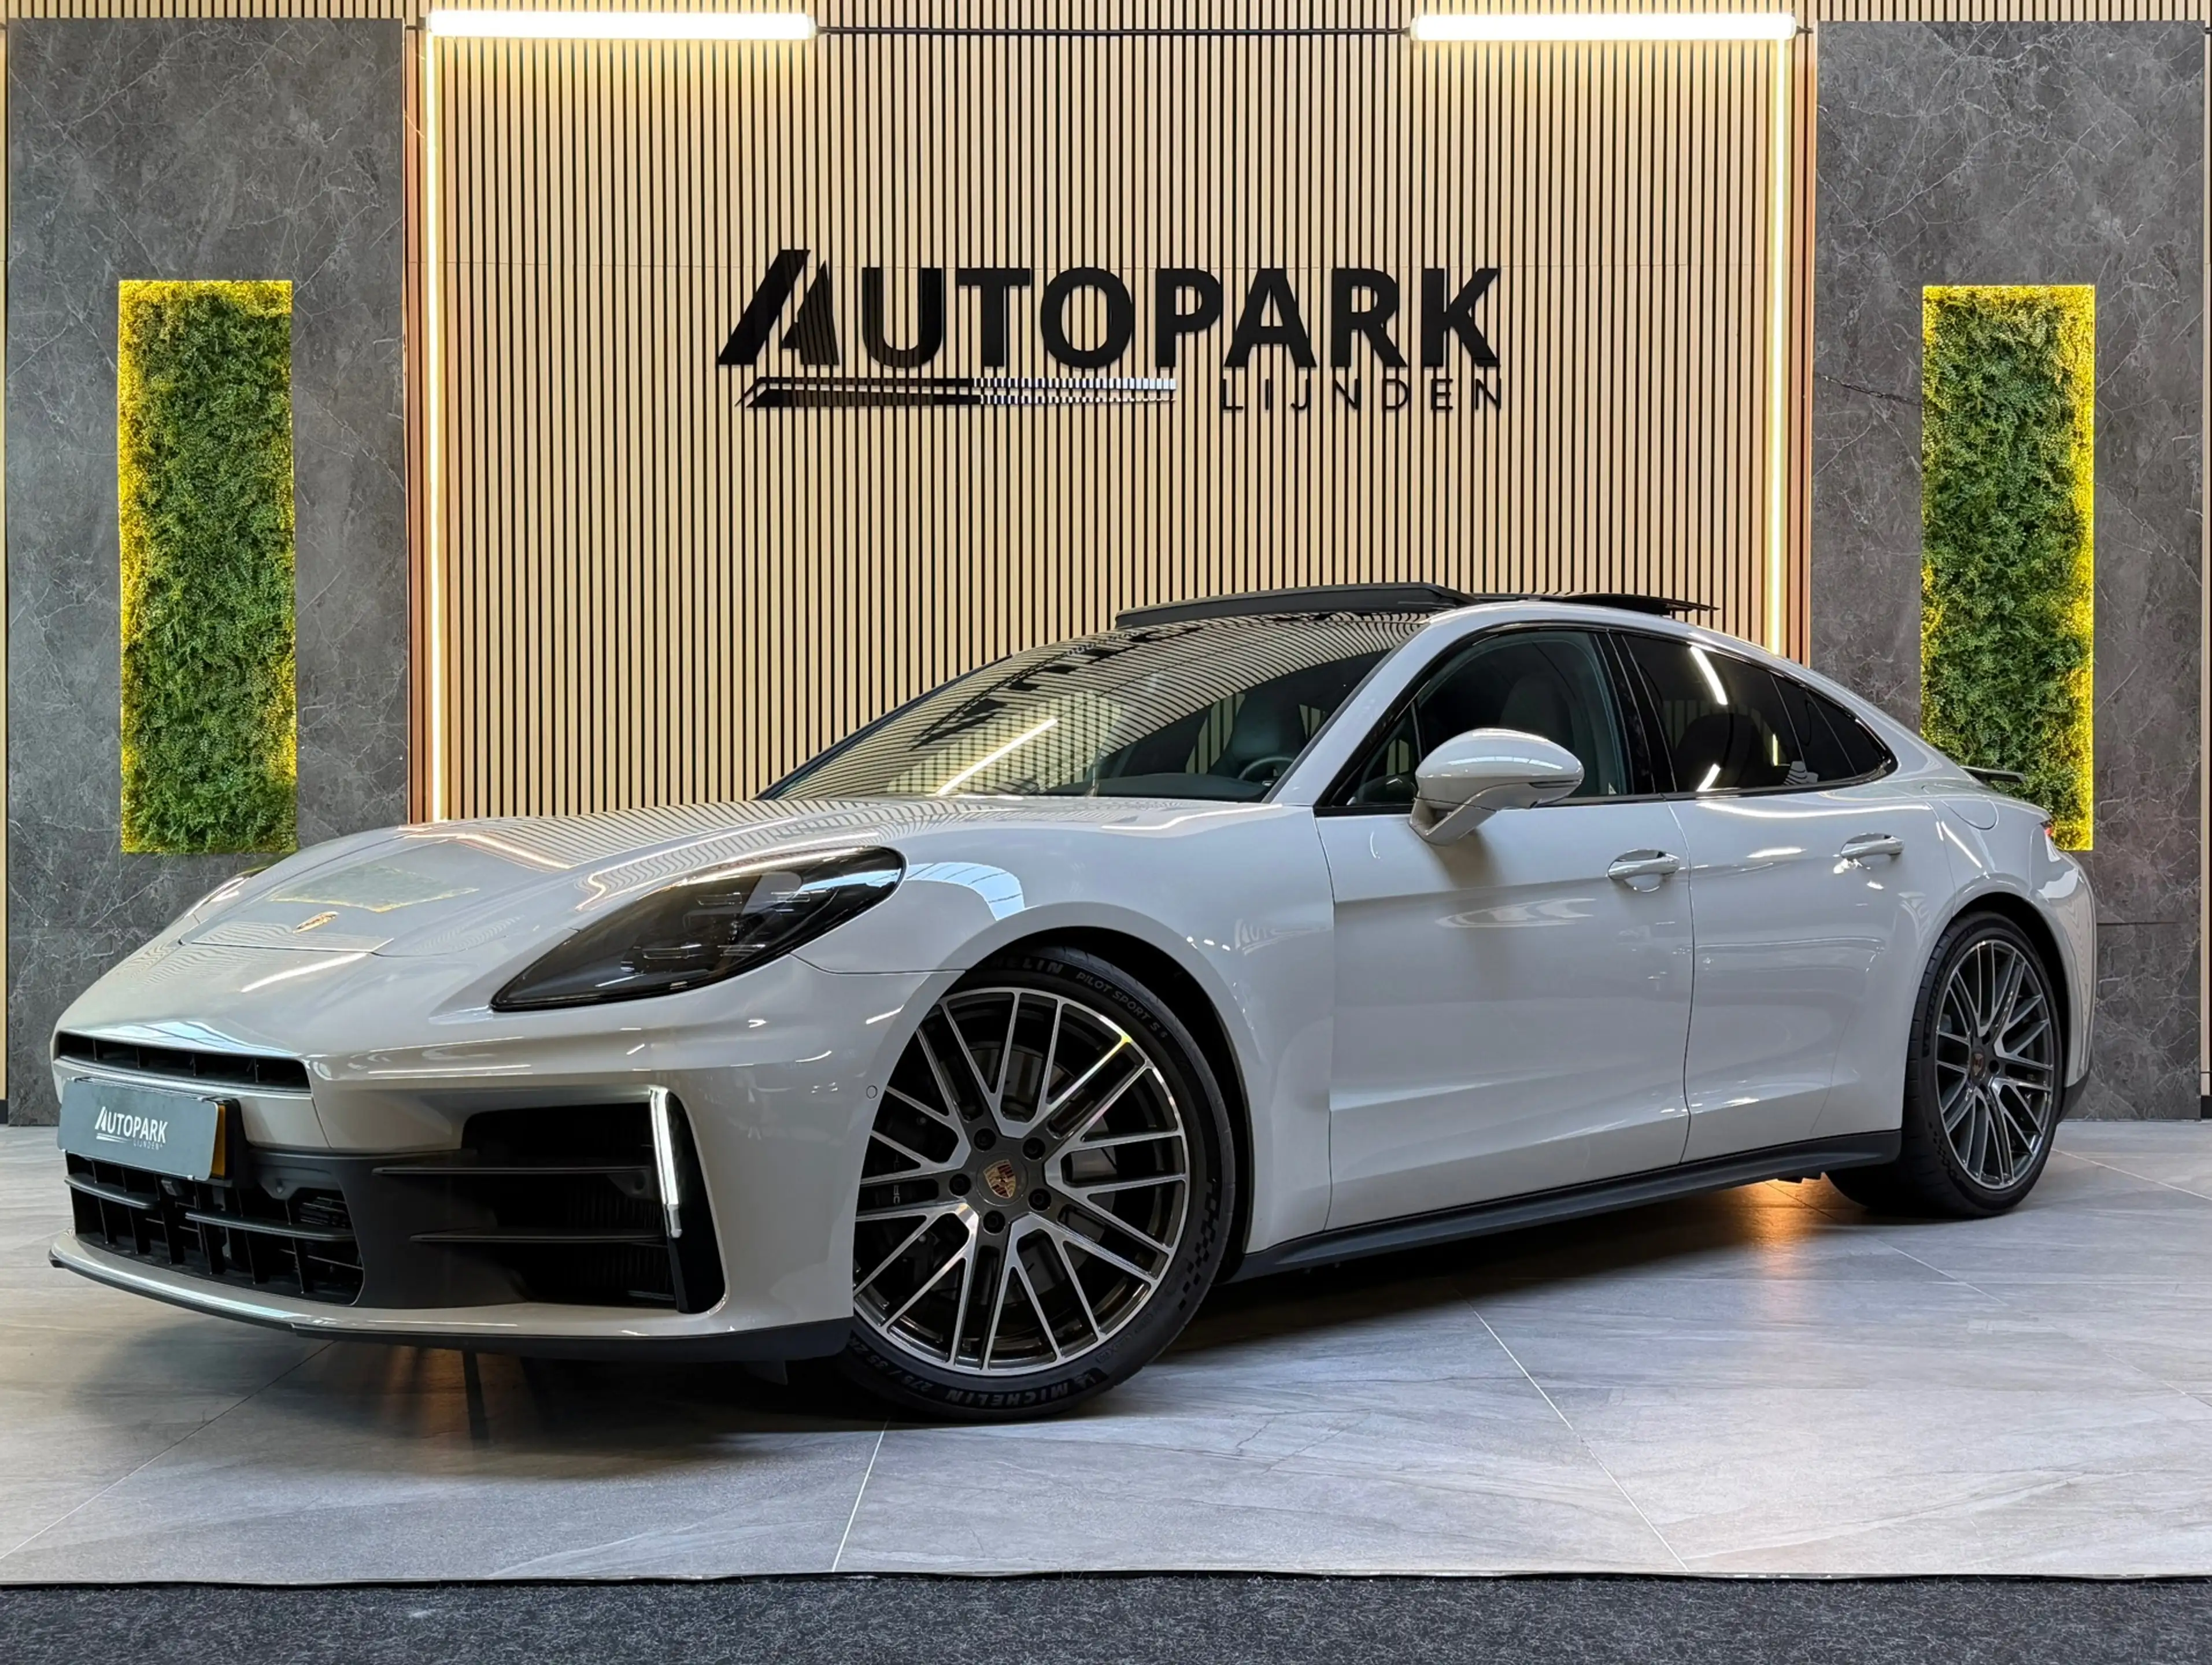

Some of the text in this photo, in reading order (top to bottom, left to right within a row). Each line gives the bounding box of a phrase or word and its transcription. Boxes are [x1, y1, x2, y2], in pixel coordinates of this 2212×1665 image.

[716, 249, 1501, 369] AUTOPARK
[1221, 379, 1503, 410] LIJNDEN
[1075, 971, 1114, 993] PILOT
[1111, 990, 1152, 1021] SPORT
[94, 1105, 168, 1144] AUTOPARK
[945, 1382, 1069, 1407] MICHELIN
